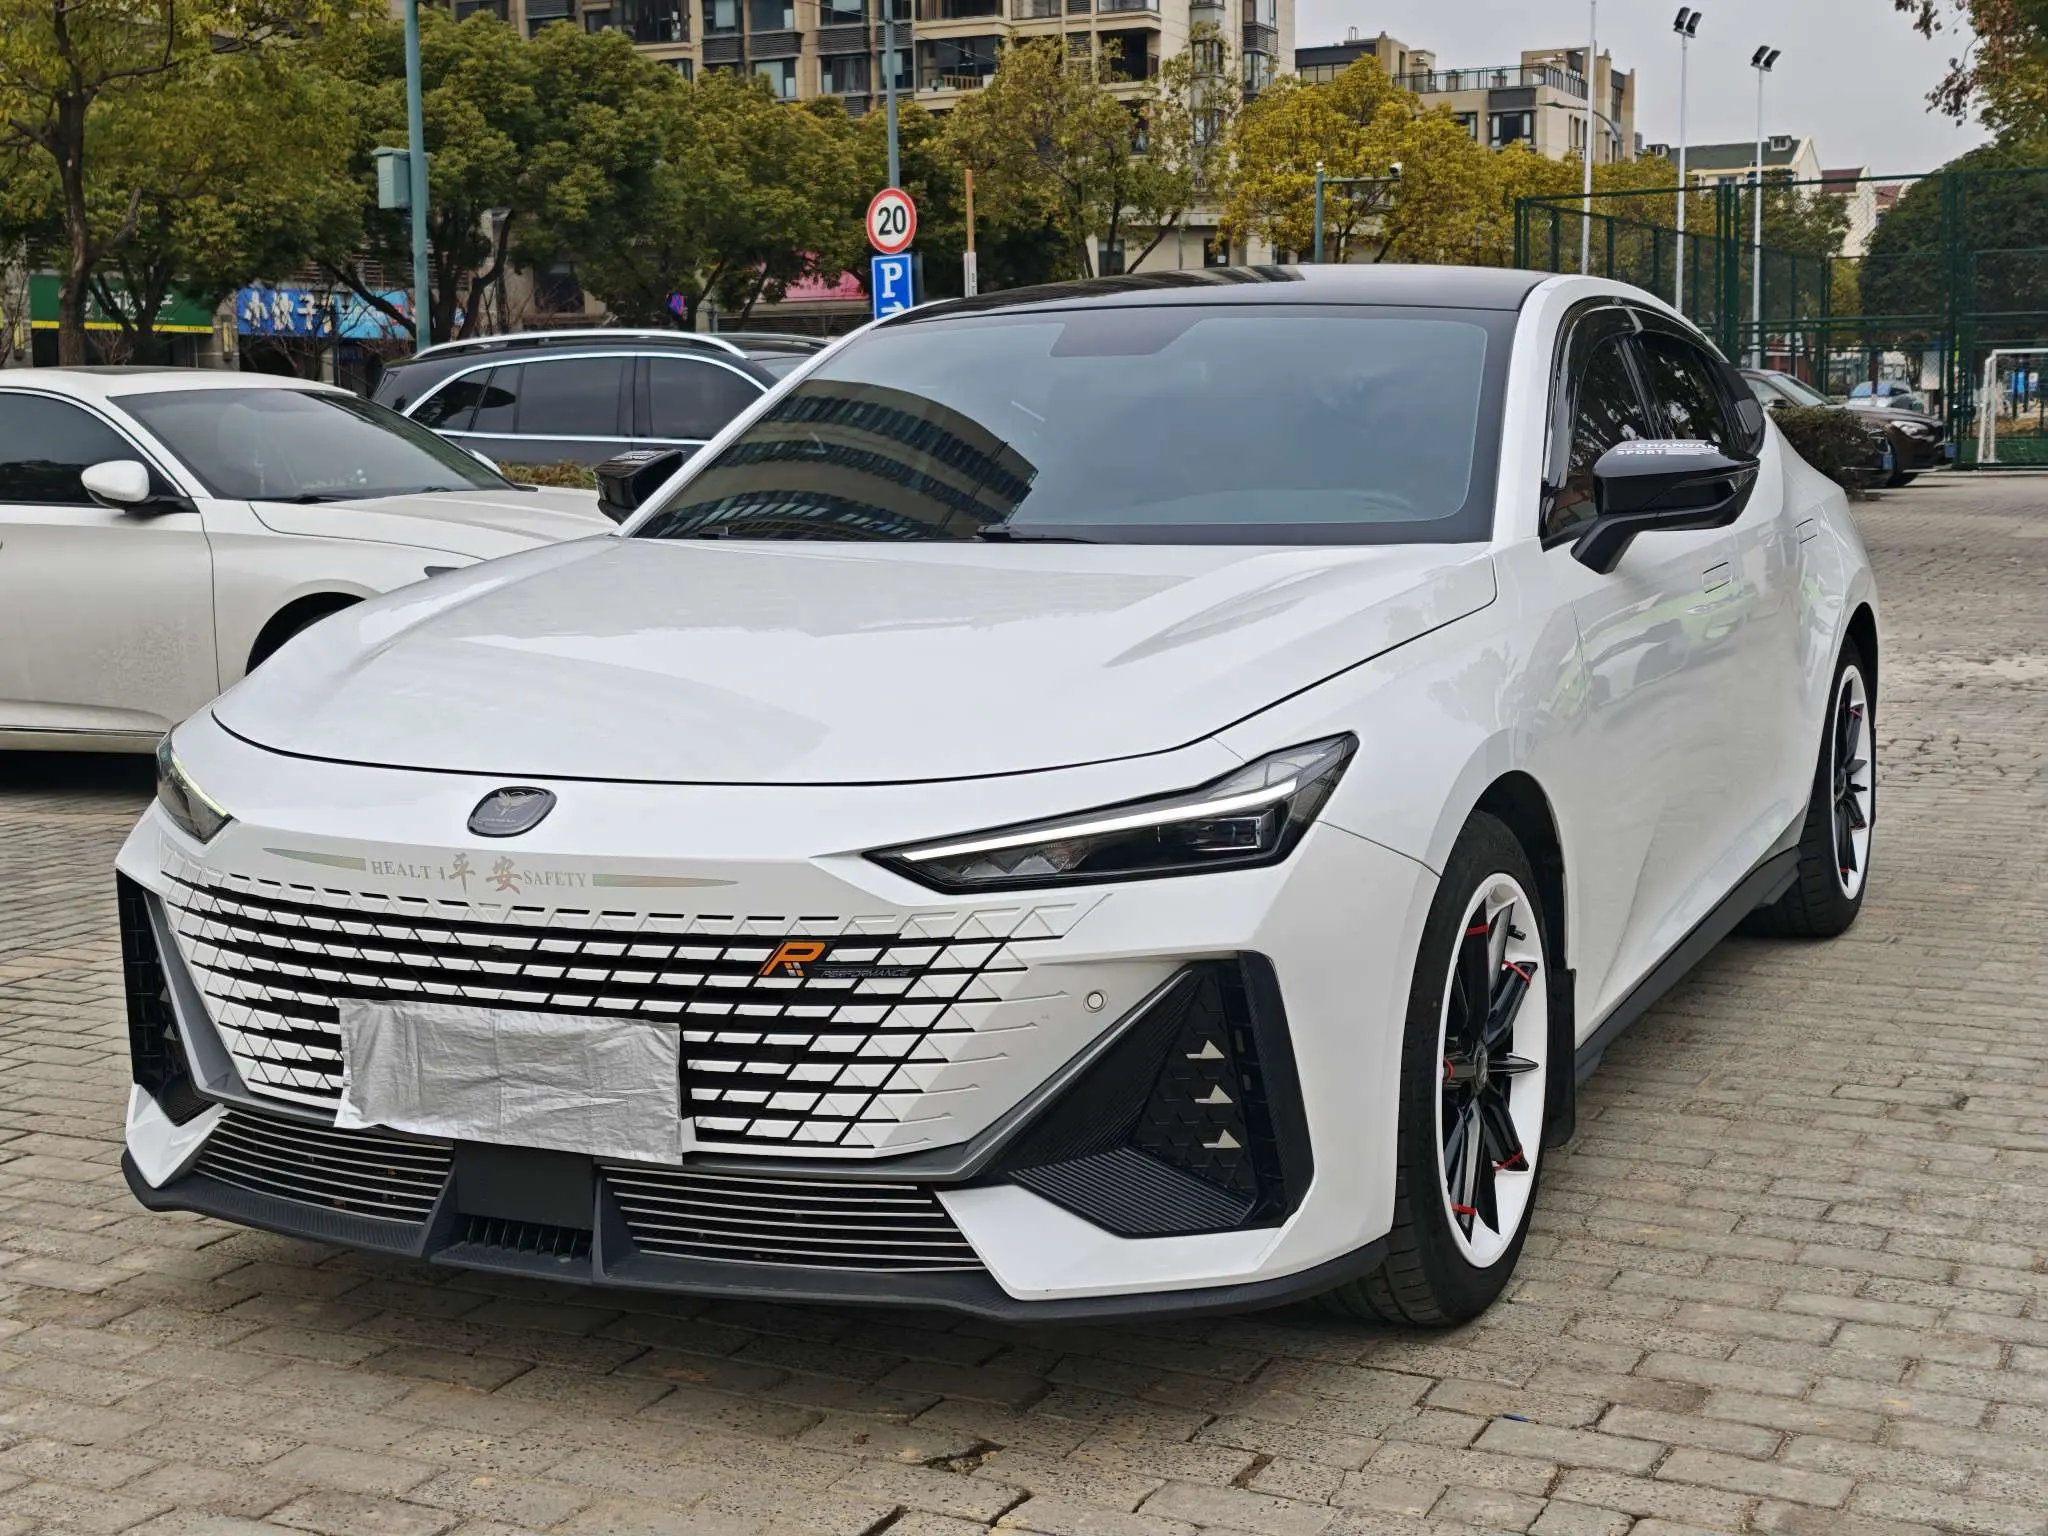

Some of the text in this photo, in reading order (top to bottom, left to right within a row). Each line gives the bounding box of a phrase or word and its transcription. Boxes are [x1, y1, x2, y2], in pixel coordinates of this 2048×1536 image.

[878, 205, 907, 236] 20
[881, 262, 902, 298] P
[449, 852, 523, 895] 平安
[523, 869, 587, 888] SAFETY
